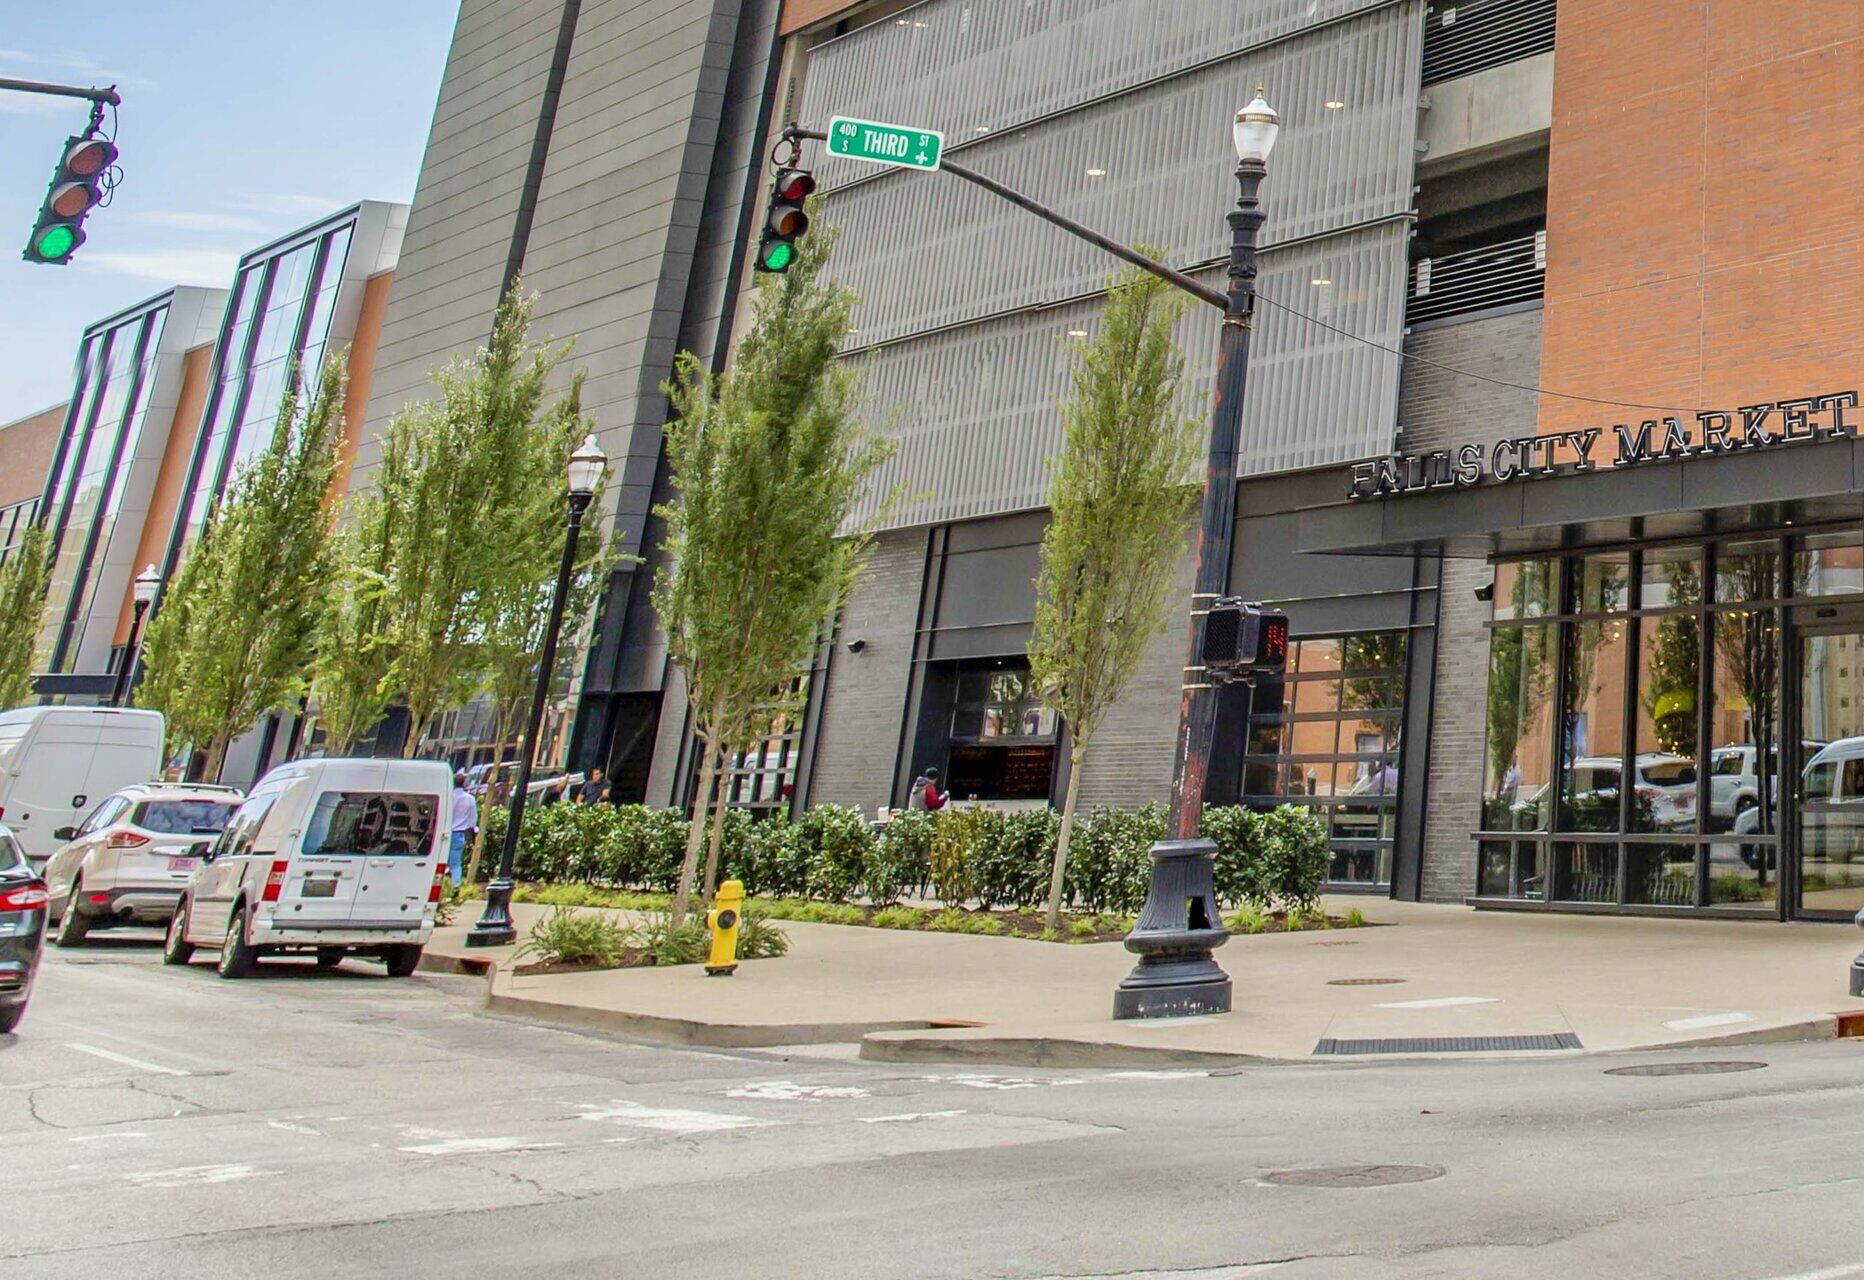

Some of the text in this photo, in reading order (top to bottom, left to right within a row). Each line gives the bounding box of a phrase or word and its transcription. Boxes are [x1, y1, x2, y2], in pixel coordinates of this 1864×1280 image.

[838, 123, 931, 158] 400 THIRD ST
[841, 140, 849, 152] S
[1347, 390, 1859, 500] FALLS CITY MARKET
